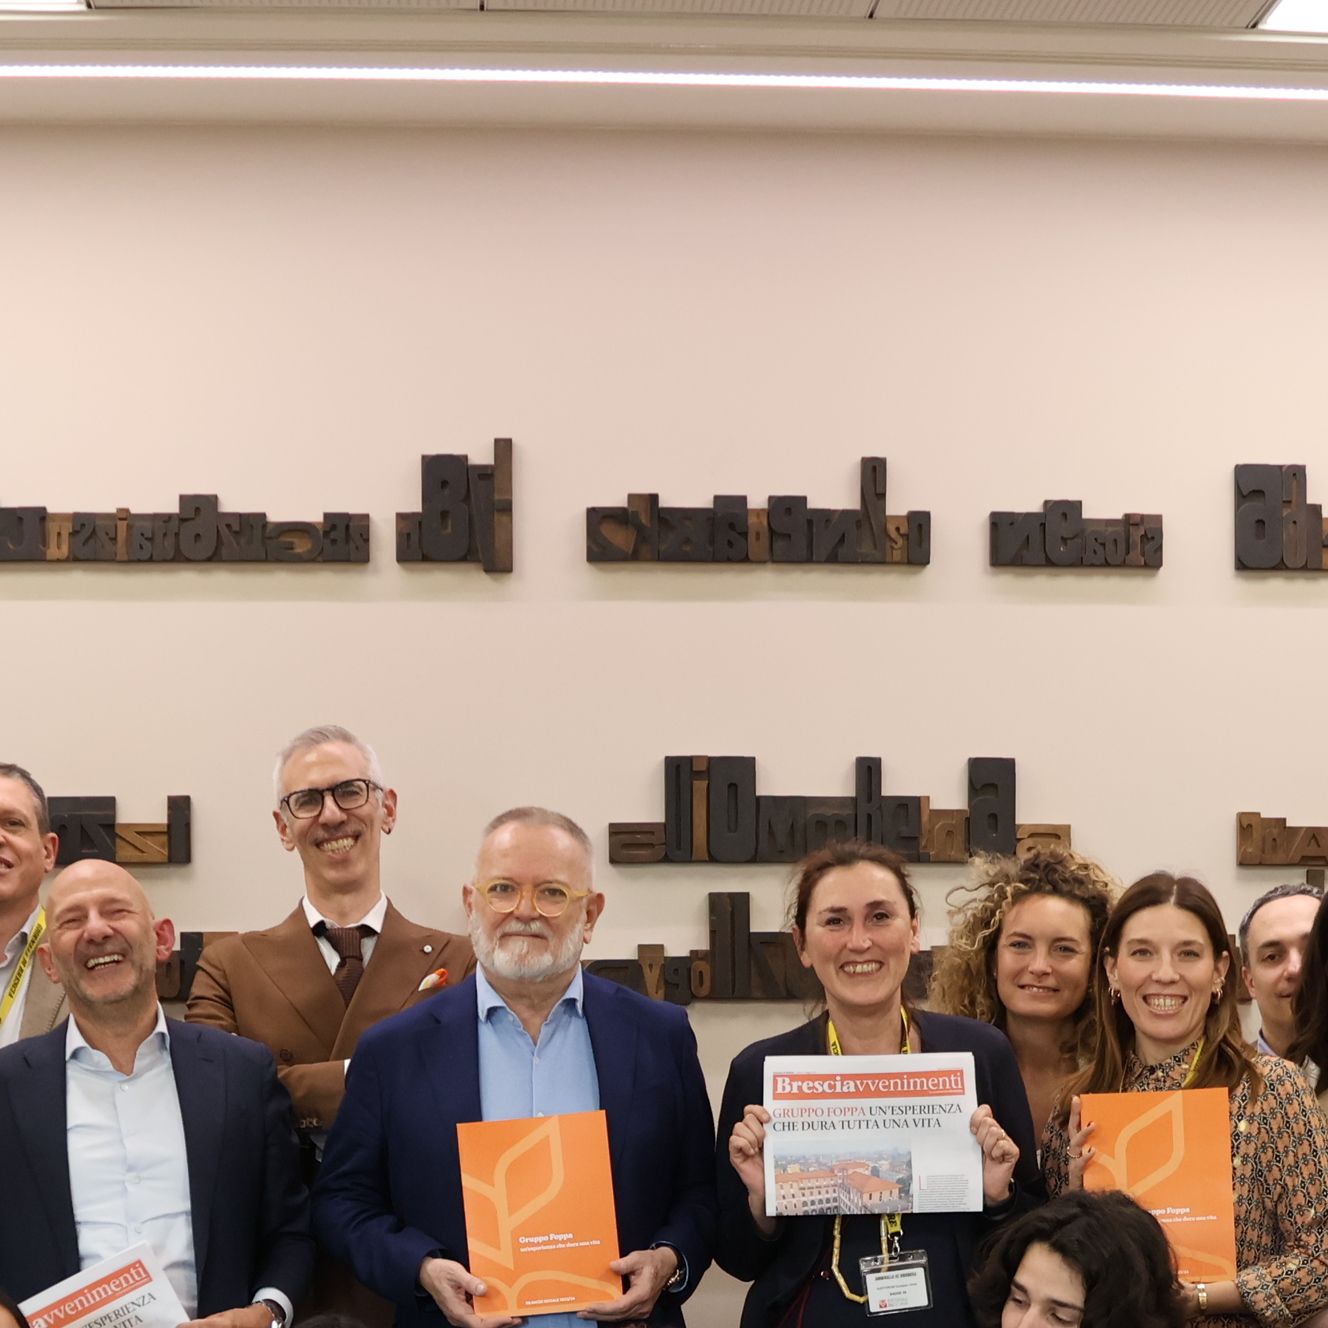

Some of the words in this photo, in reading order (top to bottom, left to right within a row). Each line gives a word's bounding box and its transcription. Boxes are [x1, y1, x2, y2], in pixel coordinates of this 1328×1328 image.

[775, 1073, 962, 1095] Bresciavvenimenti
[773, 1107, 825, 1119] GRUPPO
[827, 1107, 866, 1117] FOPPA
[869, 1104, 962, 1116] UN'ESPERIENZA
[773, 1121, 798, 1132] CHE
[802, 1120, 836, 1130] DURA
[839, 1119, 880, 1130] TUTTA
[883, 1119, 910, 1128] UNA
[912, 1118, 942, 1128] VITA
[519, 1235, 549, 1244] Gruppo
